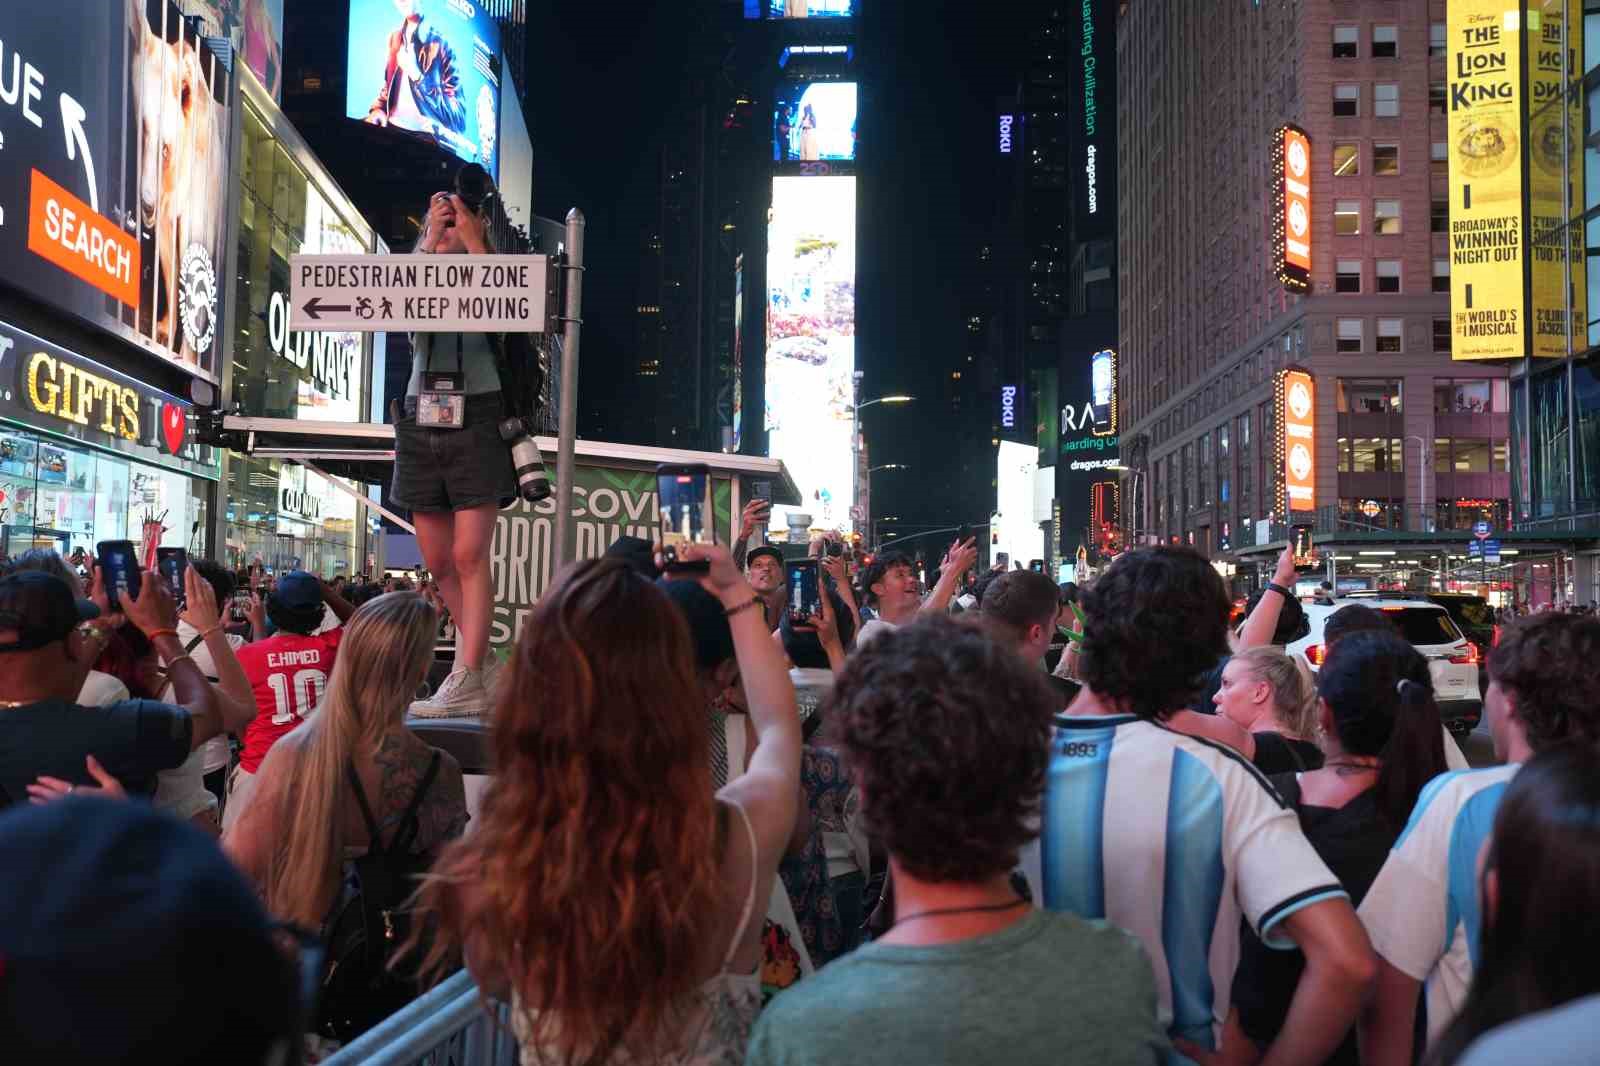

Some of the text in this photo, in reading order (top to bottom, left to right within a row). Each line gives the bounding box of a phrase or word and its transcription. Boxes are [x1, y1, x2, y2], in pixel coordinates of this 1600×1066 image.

[1463, 25, 1501, 44] THE
[1456, 51, 1507, 79] LION
[1084, 57, 1096, 135] Civilization
[1451, 81, 1513, 112] KING
[1086, 144, 1097, 214] dragos.com
[1453, 216, 1519, 233] BROADWAY'S
[44, 198, 132, 284] SEARCH
[1453, 230, 1519, 250] WINNING
[1454, 247, 1519, 265] NIGHT OUT
[302, 265, 529, 288] PEDESTRIAN FLOW ZONE
[404, 297, 529, 319] KEEP MOVING
[1469, 309, 1518, 323] WORLD'S
[1469, 322, 1518, 337] MUSICAL
[27, 352, 140, 440] GIFTS
[267, 668, 328, 725] 10
